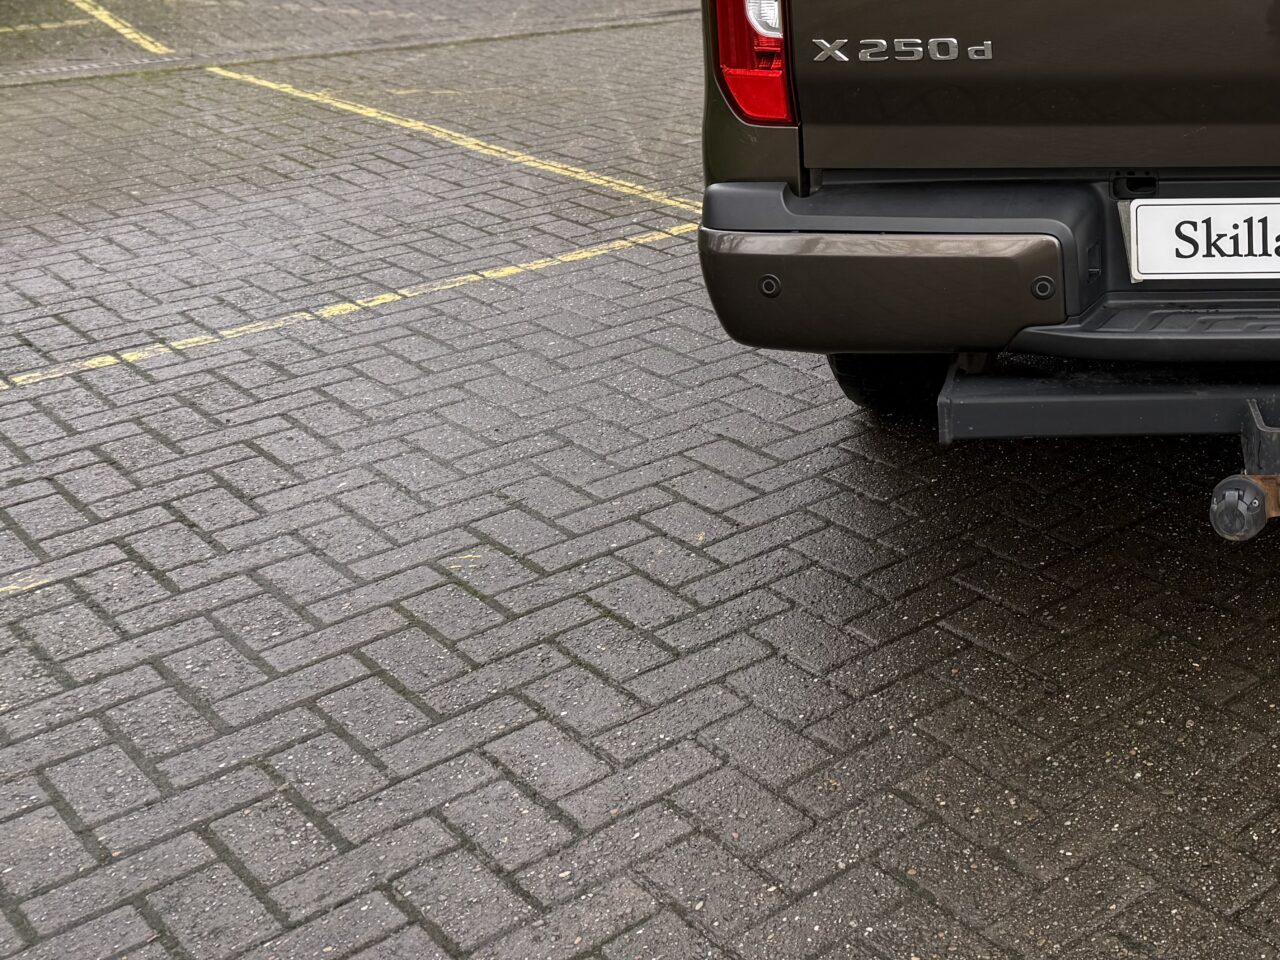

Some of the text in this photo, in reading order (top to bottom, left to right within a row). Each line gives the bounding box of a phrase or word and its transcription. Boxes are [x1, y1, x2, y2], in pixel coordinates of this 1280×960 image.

[812, 38, 993, 61] X 250 d
